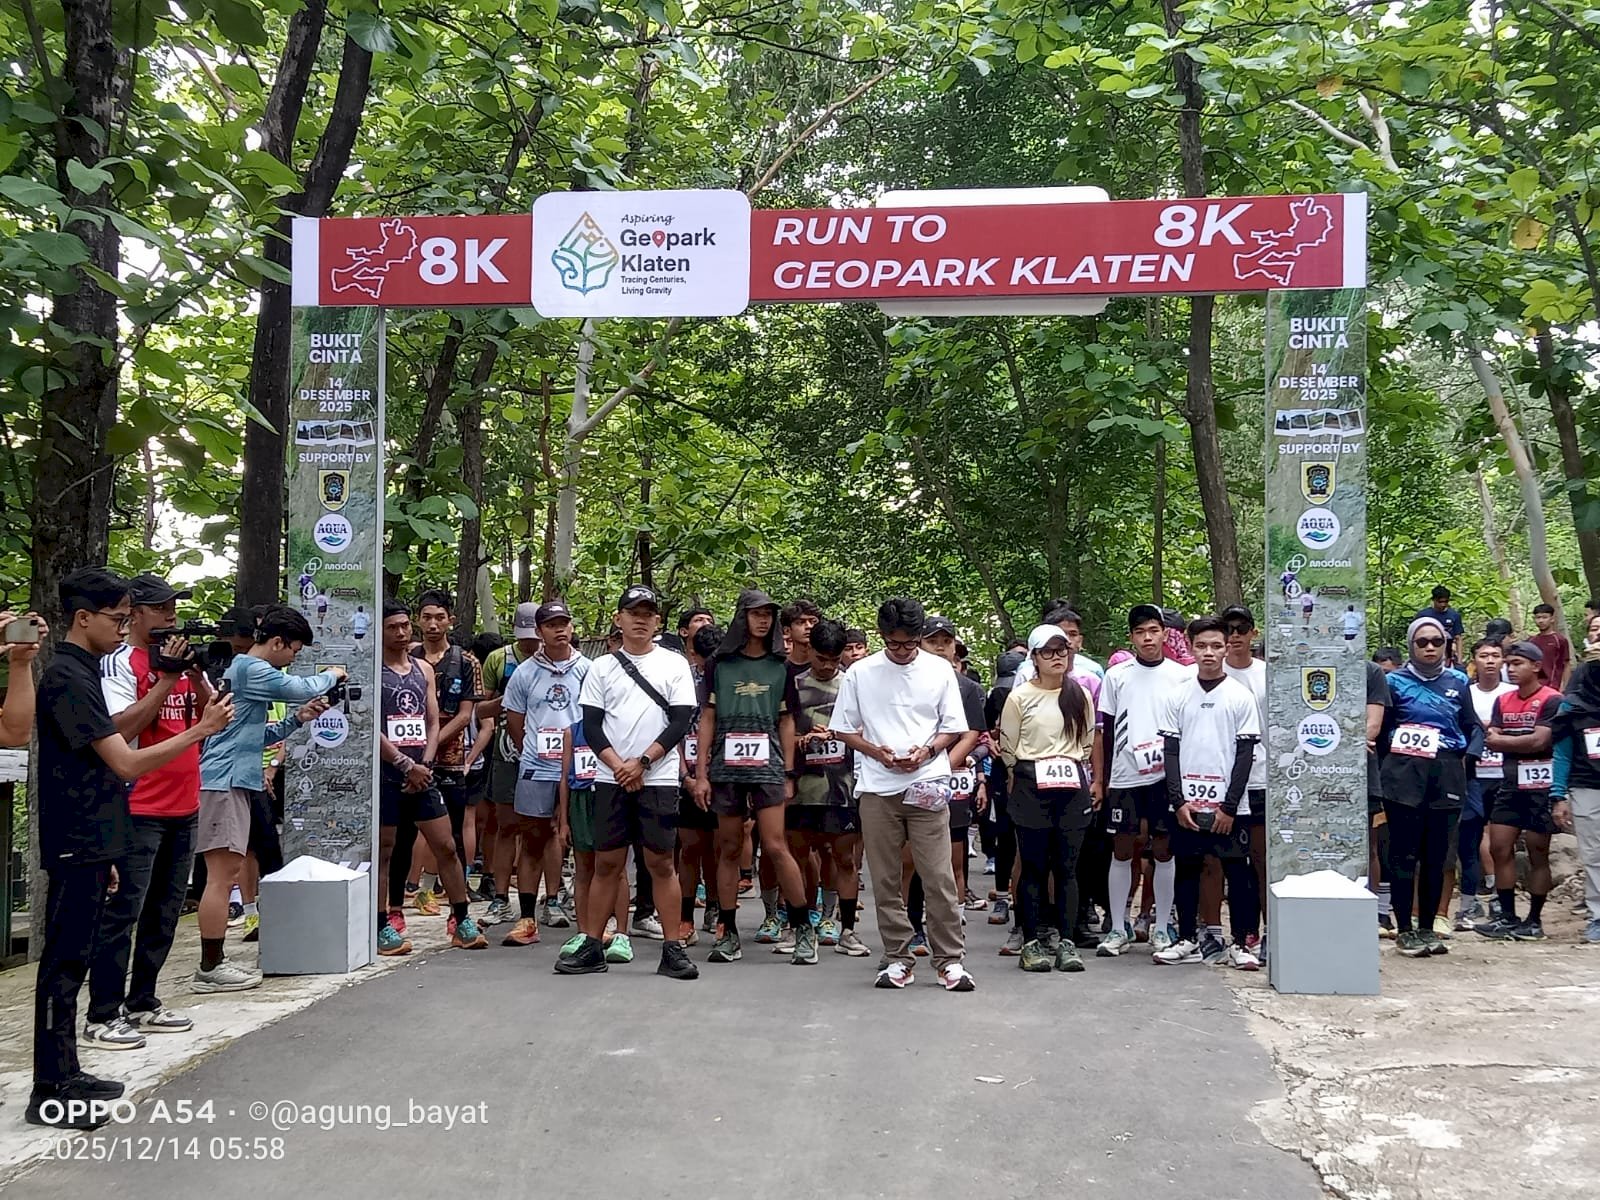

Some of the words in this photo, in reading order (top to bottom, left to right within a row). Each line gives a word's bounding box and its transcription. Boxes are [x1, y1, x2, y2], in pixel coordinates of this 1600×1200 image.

[621, 213, 675, 226] Aspiring
[1153, 202, 1253, 248] 8K
[772, 216, 873, 246] RUN
[886, 214, 948, 244] TO
[418, 237, 509, 285] 8K
[621, 253, 690, 272] Klaten
[772, 257, 1000, 290] GEOPARK
[1009, 253, 1196, 286] KLATEN
[620, 275, 648, 285] Tracing
[649, 275, 687, 284] Centuries,
[621, 286, 644, 296] Living
[645, 286, 672, 296] Gravity
[1289, 316, 1349, 332] BUKIT
[310, 333, 362, 348] BUKIT
[1289, 333, 1349, 349] CINTA
[309, 349, 363, 364] CINTA
[1310, 363, 1327, 375] 14
[329, 377, 343, 389] 14
[1279, 376, 1358, 389] DESEMBER
[300, 389, 371, 401] DESEMBER
[1300, 388, 1338, 400] 2025
[319, 401, 353, 412] 2025
[1278, 443, 1340, 454] SUPPORT
[1341, 442, 1360, 453] BY
[298, 452, 353, 463] SUPPORT
[355, 452, 372, 463] BY
[316, 523, 348, 535] AQUA
[1300, 518, 1335, 530] AQUA
[1309, 557, 1352, 568] madani
[313, 718, 344, 731] AQUA
[394, 723, 423, 737] 035
[1300, 724, 1335, 736] AQUA
[1400, 731, 1430, 748] 096
[734, 743, 761, 756] 217
[1046, 765, 1073, 778] 418
[1525, 768, 1551, 781] 132
[1188, 783, 1218, 799] 396
